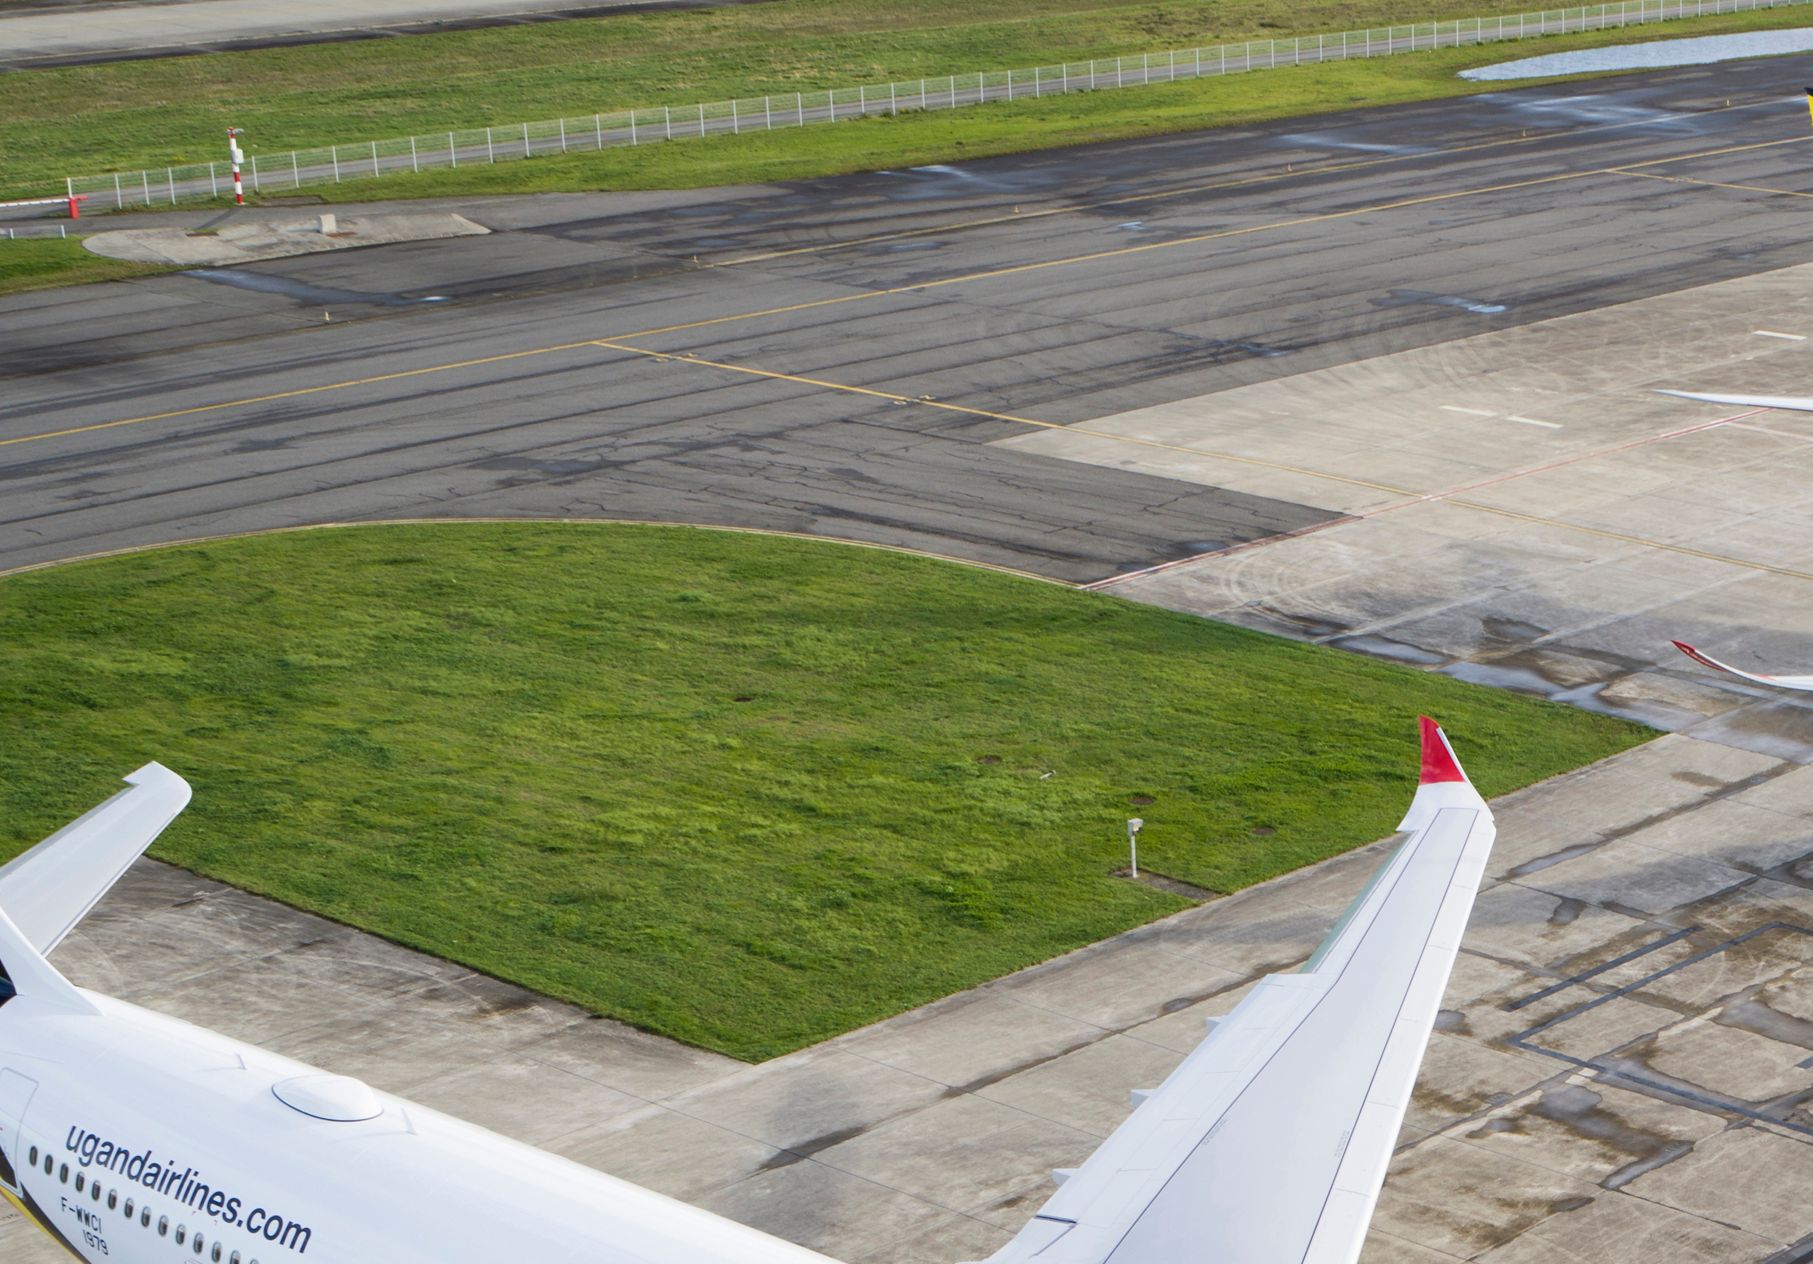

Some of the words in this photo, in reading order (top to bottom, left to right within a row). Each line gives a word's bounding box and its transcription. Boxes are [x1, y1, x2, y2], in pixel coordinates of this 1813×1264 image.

[66, 1125, 312, 1254] ugandairlines.com
[60, 1197, 102, 1234] F-WWCI
[83, 1230, 109, 1256] 1979
